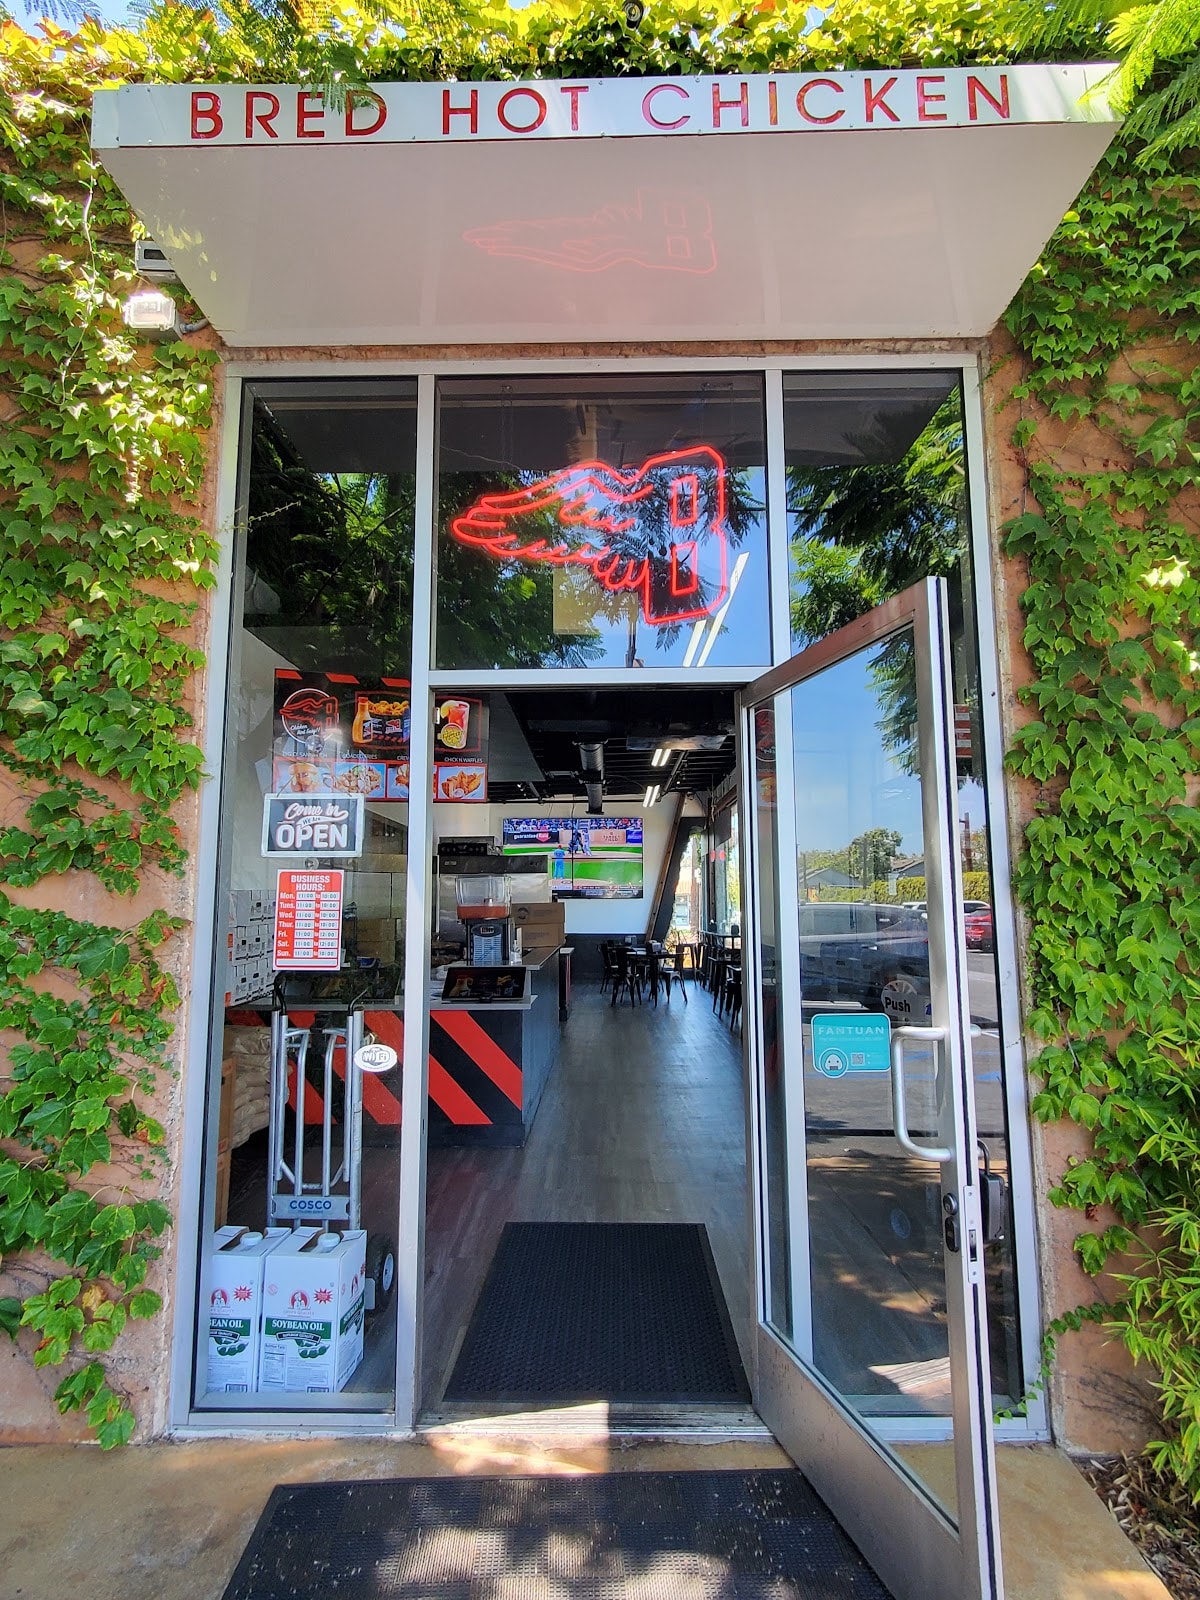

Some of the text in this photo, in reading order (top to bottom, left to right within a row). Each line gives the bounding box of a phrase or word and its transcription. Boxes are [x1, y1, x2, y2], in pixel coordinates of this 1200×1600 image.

[190, 74, 1010, 139] BRED HOT CHICKEN
[285, 803, 349, 819] Come in
[276, 823, 348, 848] OPEN
[291, 875, 330, 883] BUSINESS
[296, 883, 325, 891] HOURS:
[885, 997, 911, 1012] Push
[818, 1026, 884, 1035] FANTUAN
[290, 1200, 331, 1209] COSCO
[229, 1320, 243, 1328] OIL
[272, 1319, 325, 1331] SOYBEAN OIL
